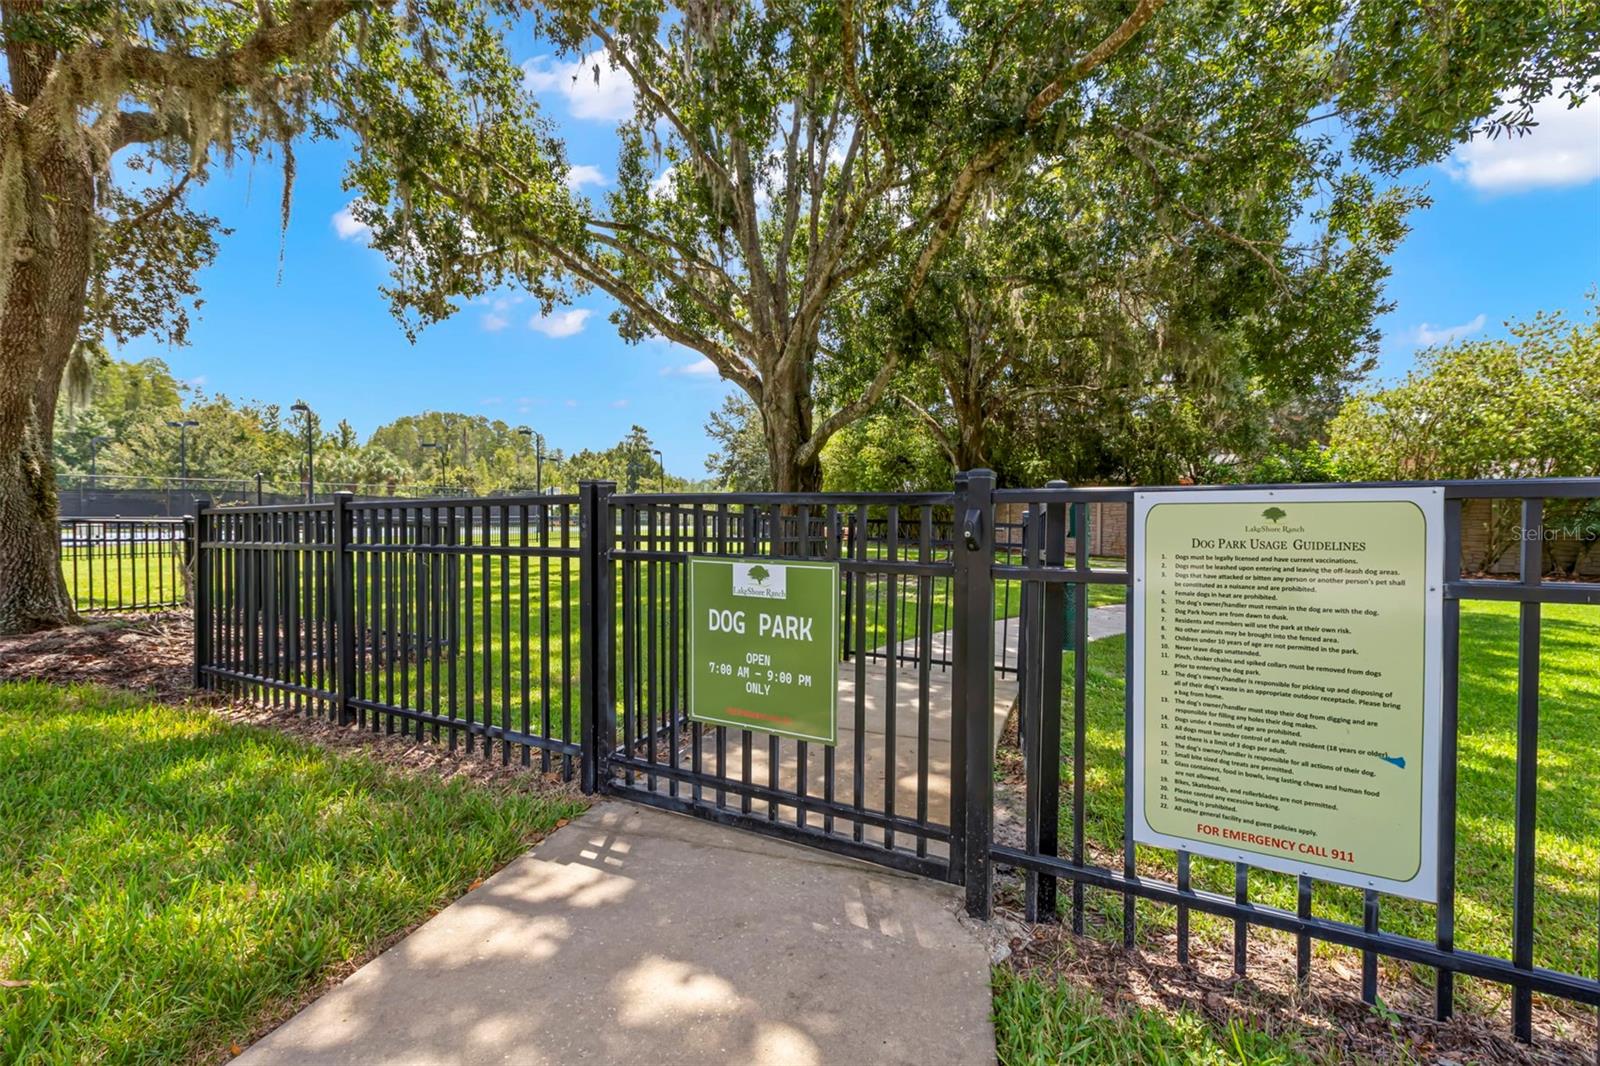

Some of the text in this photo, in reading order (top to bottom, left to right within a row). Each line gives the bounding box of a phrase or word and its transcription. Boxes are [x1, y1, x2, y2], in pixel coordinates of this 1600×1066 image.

[1214, 554, 1234, 562] legally
[1255, 566, 1282, 574] entering
[1296, 566, 1320, 575] leaving
[1364, 568, 1378, 576] dog
[708, 609, 813, 642] DOG PARK
[1175, 616, 1202, 625] Residents
[1175, 634, 1198, 643] Children
[1247, 630, 1272, 640] brought
[1299, 634, 1321, 642] fenced
[1175, 643, 1192, 651] Never
[1192, 644, 1208, 653] leave
[746, 652, 771, 666] OPEN
[1193, 654, 1213, 663] choker
[1213, 656, 1233, 664] chains
[1246, 660, 1266, 668] spiked
[1267, 661, 1288, 669] collars
[1347, 667, 1364, 675] from
[1365, 668, 1382, 678] dogs
[709, 662, 732, 675] 7:00
[737, 666, 749, 677] AM
[767, 670, 792, 684] 9:00
[799, 674, 811, 687] PM
[1196, 664, 1221, 673] entering
[746, 682, 771, 695] ONLY
[1189, 681, 1203, 689] their
[1255, 689, 1292, 698] appropriate
[1292, 692, 1320, 701] outdoor
[1358, 698, 1381, 707] Please
[1382, 700, 1401, 710] bring
[1254, 680, 1290, 689] responsible
[1302, 684, 1326, 694] picking
[1350, 687, 1384, 698] disposing
[1175, 708, 1208, 717] responsible
[1218, 712, 1235, 722] filling
[1247, 715, 1265, 724] holes
[1265, 717, 1281, 726] their
[1189, 718, 1207, 726] under
[1212, 722, 1235, 730] months
[1264, 708, 1279, 717] stop
[1279, 709, 1295, 718] their
[1309, 712, 1326, 721] from
[1326, 714, 1351, 725] digging
[1186, 735, 1203, 743] there
[1214, 738, 1228, 747] limit
[1222, 731, 1240, 739] under
[1240, 734, 1263, 742] control
[1280, 738, 1298, 746] adult
[1298, 741, 1325, 750] resident
[1175, 751, 1190, 760] Small
[1203, 756, 1218, 764] sized
[1231, 759, 1249, 768] treats
[1253, 755, 1290, 765] responsible
[1310, 762, 1334, 771] actions
[1343, 766, 1360, 774] their
[1265, 774, 1280, 784] long
[1280, 776, 1302, 788] lasting
[1303, 780, 1323, 789] chews
[1338, 785, 1363, 795] human
[1363, 788, 1380, 798] food
[1175, 786, 1193, 796] Please
[1193, 791, 1214, 799] control
[1226, 796, 1254, 806] excessive
[1175, 795, 1199, 807] Smoking
[1242, 790, 1279, 801] rollerblades
[1183, 807, 1199, 815] other
[1199, 810, 1221, 820] general
[1222, 813, 1242, 824] facility
[1255, 820, 1273, 828] guest
[1272, 823, 1297, 832] policies
[1197, 824, 1354, 863] FOR EMERGENCY CALL 911
